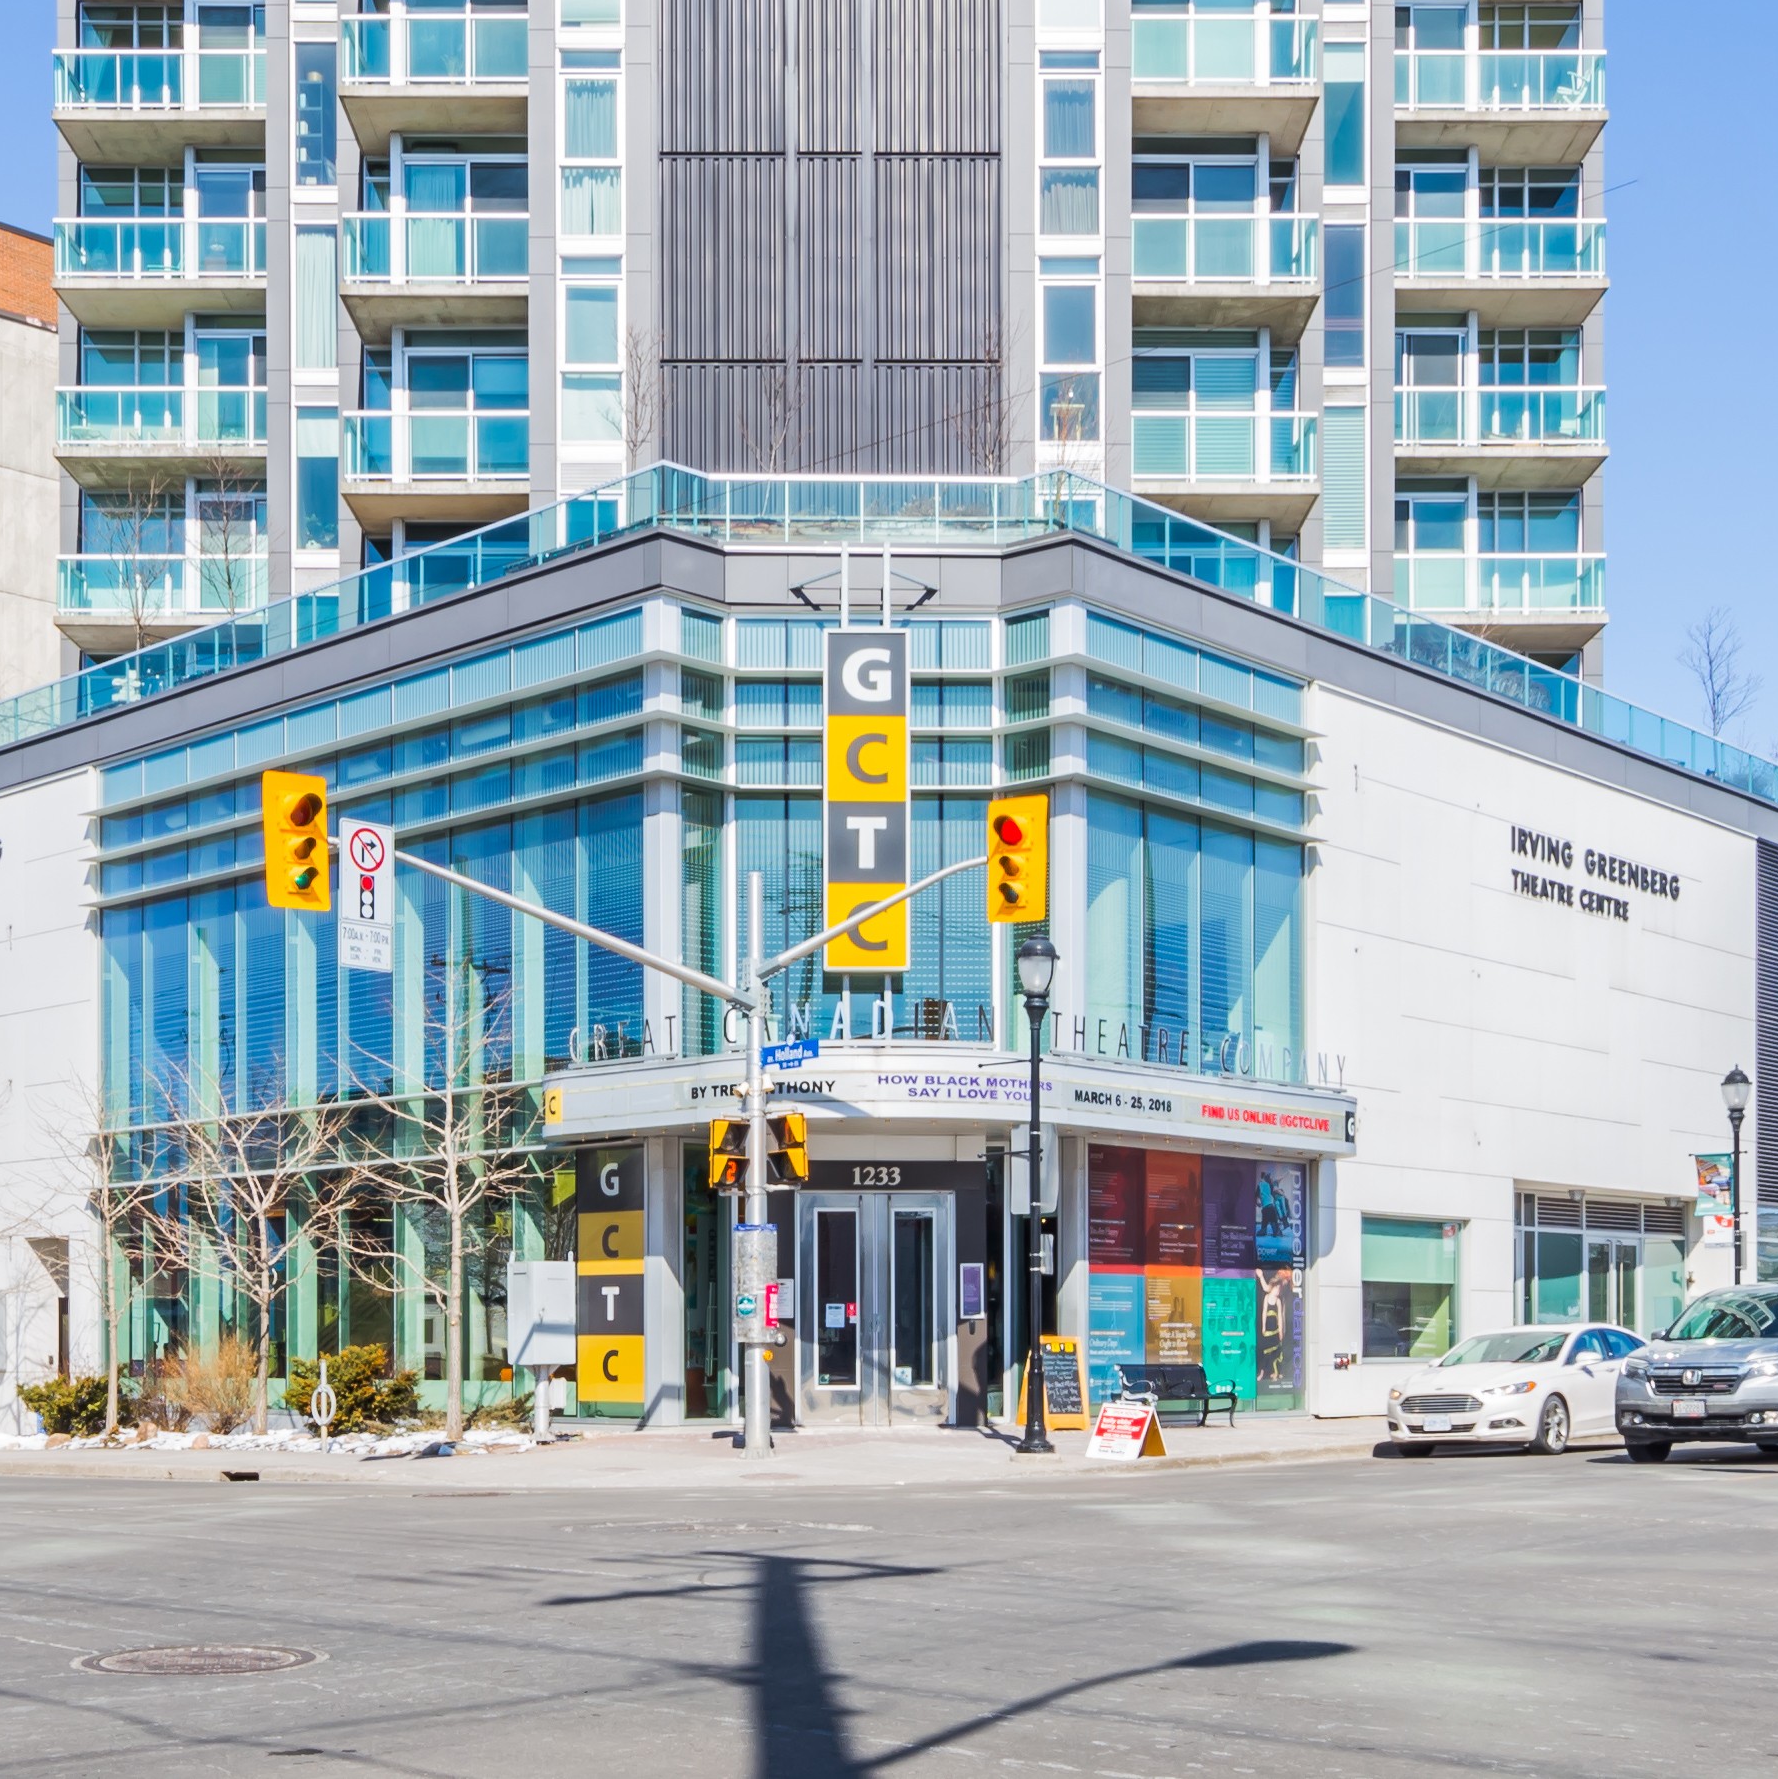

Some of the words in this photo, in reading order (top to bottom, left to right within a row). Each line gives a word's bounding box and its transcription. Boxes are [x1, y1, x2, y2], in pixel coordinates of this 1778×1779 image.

[1510, 825, 1574, 870] IRVING
[1584, 848, 1681, 902] GREENBERG
[1511, 868, 1574, 908] THEATRE
[1579, 888, 1630, 922] CENTRE
[569, 1015, 676, 1063] GREAT
[1051, 1011, 1189, 1066] THEATRE
[1221, 1033, 1346, 1087] COMPANY
[775, 1044, 803, 1061] Holland
[691, 1085, 706, 1100] BY
[711, 1083, 741, 1098] TRE
[877, 1075, 919, 1085] HOW
[924, 1075, 981, 1087] BLACK
[908, 1087, 940, 1098] SAY
[947, 1088, 952, 1098] I
[958, 1088, 998, 1100] LOVE
[1003, 1090, 1032, 1102] YOU
[1074, 1089, 1112, 1107] MARCH
[1115, 1094, 1122, 1107] 6
[1148, 1098, 1172, 1114] 2018
[1201, 1104, 1225, 1120] FIND
[1227, 1107, 1239, 1122] US
[1242, 1108, 1277, 1127] ONLINE
[852, 1166, 901, 1186] 1233
